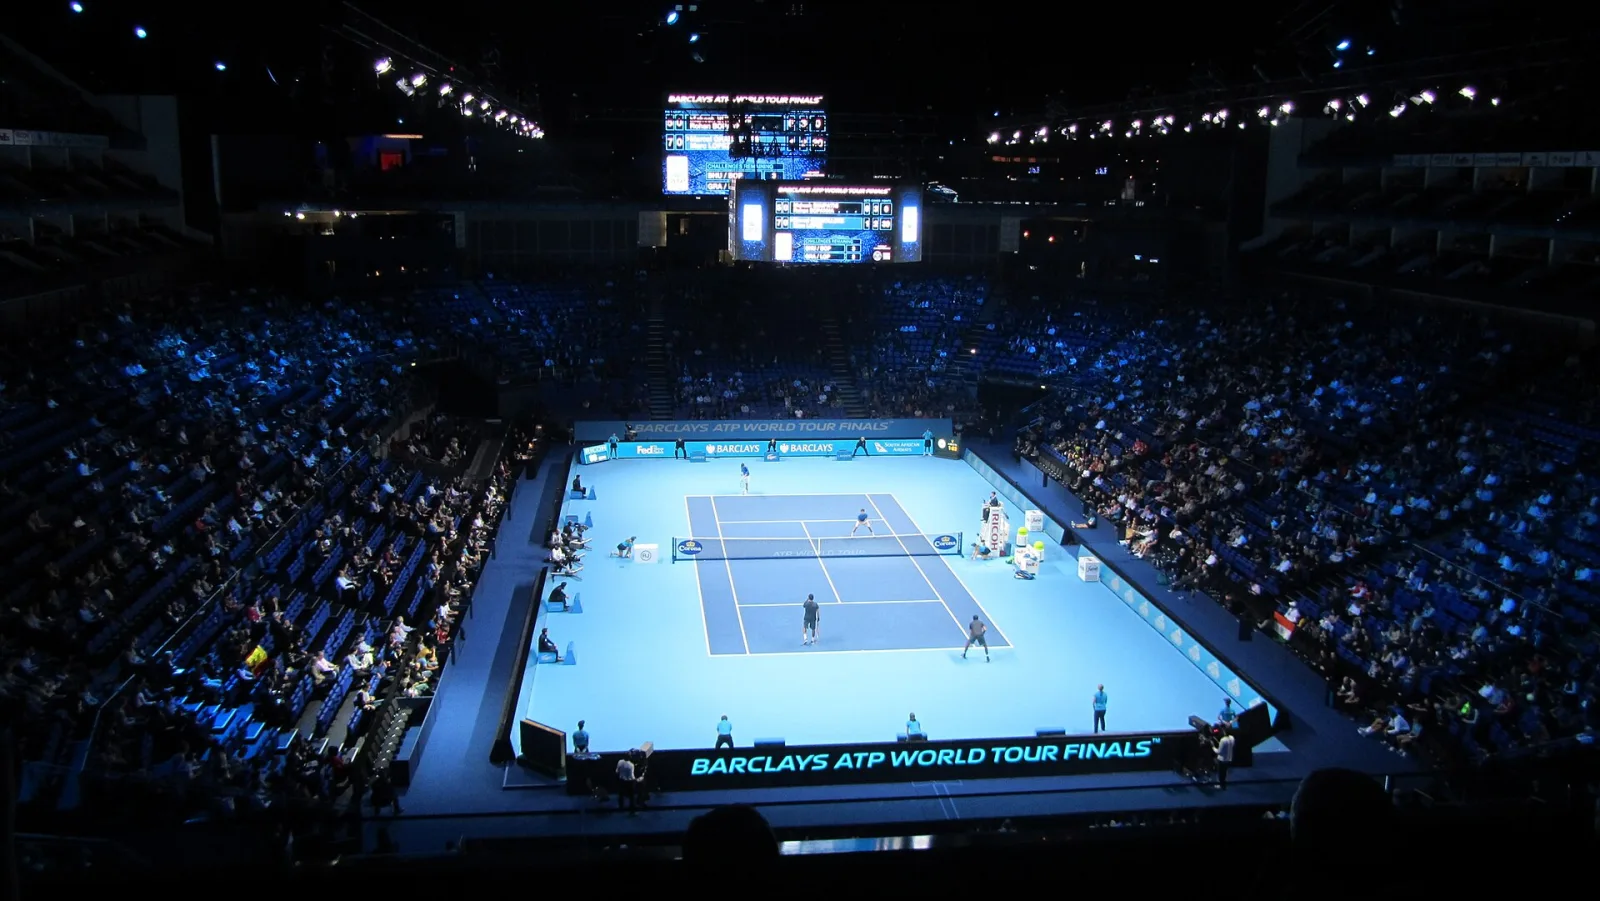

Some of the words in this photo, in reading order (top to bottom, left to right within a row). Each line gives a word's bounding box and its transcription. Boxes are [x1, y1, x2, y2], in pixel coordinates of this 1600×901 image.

[669, 95, 713, 103] BARCLAYS
[765, 96, 788, 104] TOUR
[667, 138, 673, 147] 7
[676, 138, 682, 147] 0
[635, 423, 709, 433] BARCLAYS
[712, 422, 741, 433] ATP
[743, 422, 796, 433] WORLD
[798, 421, 836, 432] TOUR
[636, 445, 664, 455] FedEx
[716, 444, 760, 453] BARCLAYS
[790, 443, 833, 452] BARCLAYS
[991, 513, 1000, 551] RICOH
[691, 754, 829, 775] BARCLAYS
[833, 752, 885, 769] ATP
[890, 748, 986, 767] WORLD
[990, 744, 1059, 764] TOUR
